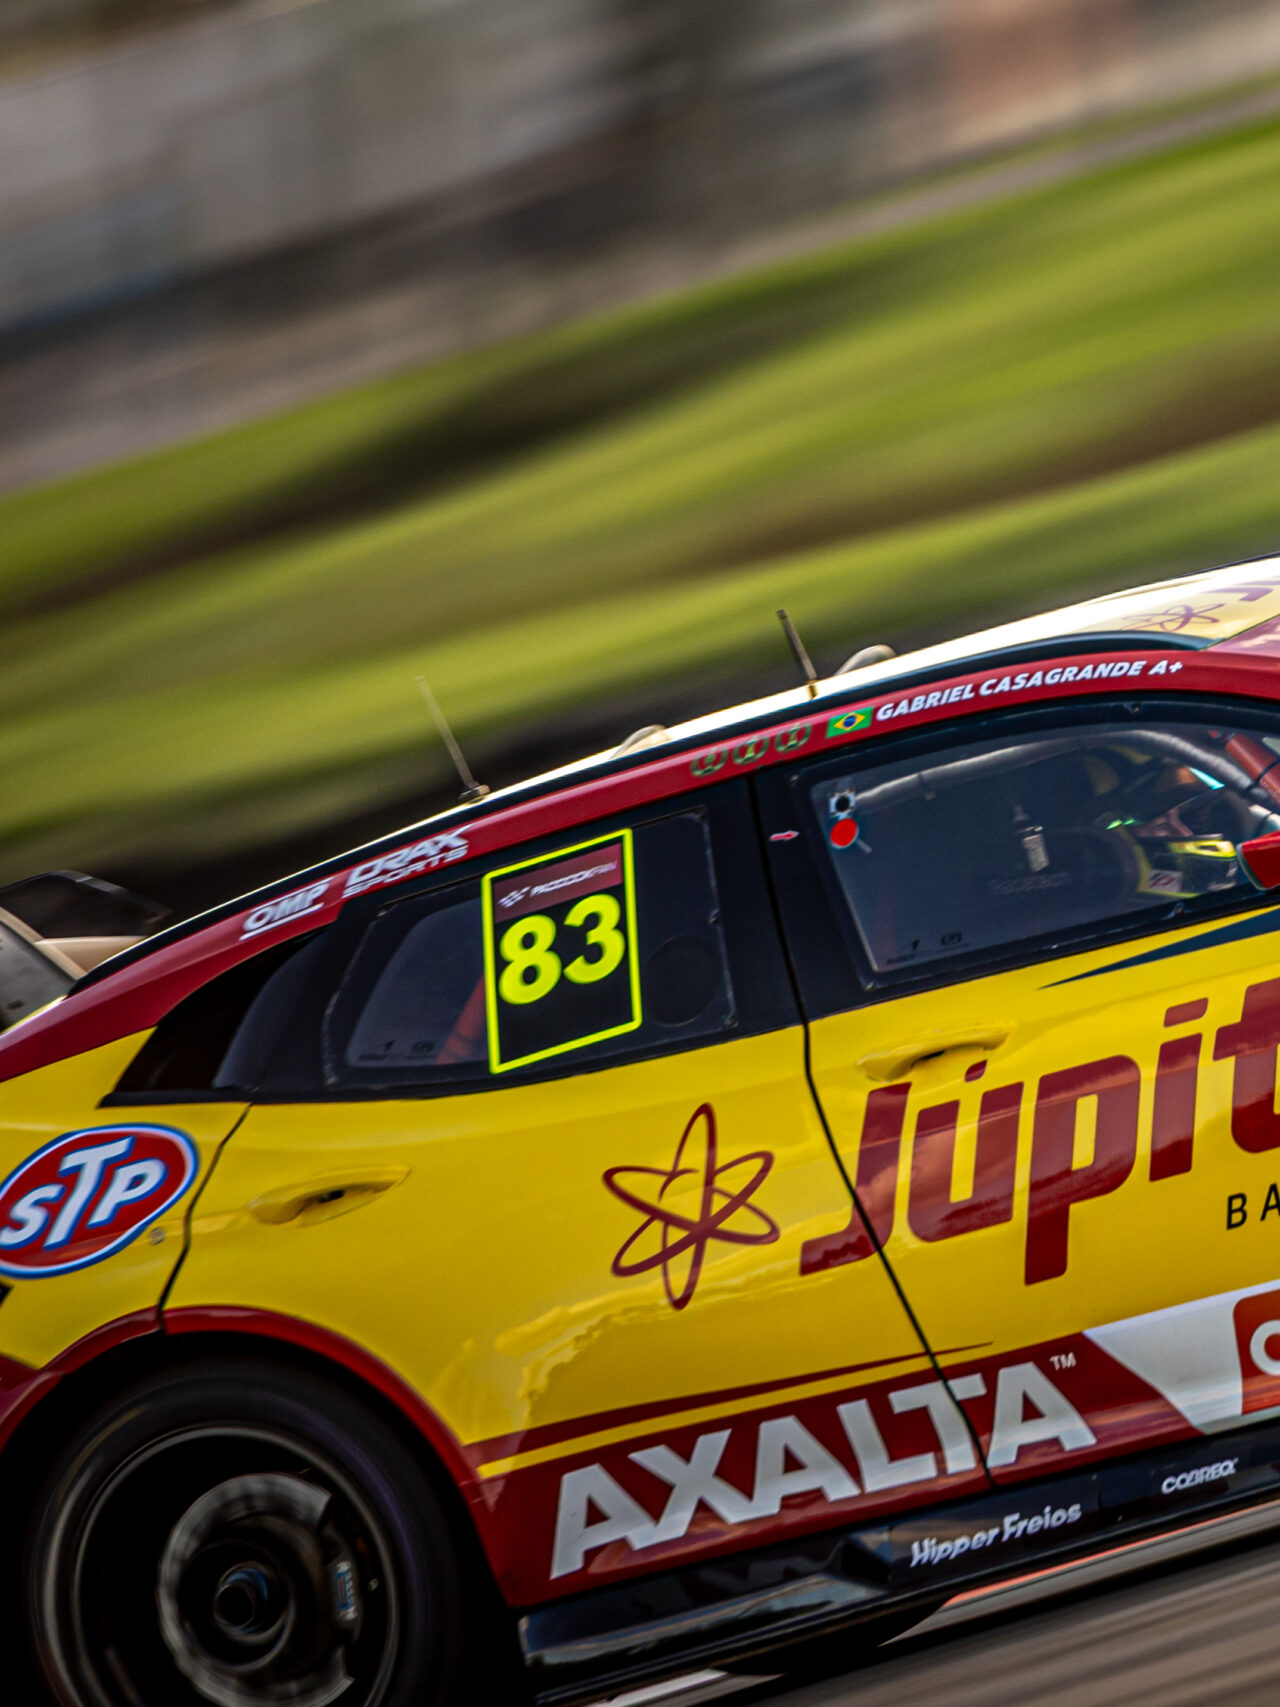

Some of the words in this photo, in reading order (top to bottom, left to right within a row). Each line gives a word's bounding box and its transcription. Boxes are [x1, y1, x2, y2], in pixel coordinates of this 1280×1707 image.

[876, 682, 975, 722] GABRIEL
[979, 660, 1147, 697] CASAGRANDE
[1148, 659, 1184, 676] A+
[242, 880, 331, 932] OMP
[498, 893, 626, 1005] 83
[0, 1135, 168, 1249] STP
[550, 1361, 1097, 1580] AXALTA
[909, 1526, 1000, 1568] Hipper
[1002, 1503, 1082, 1542] Freios
